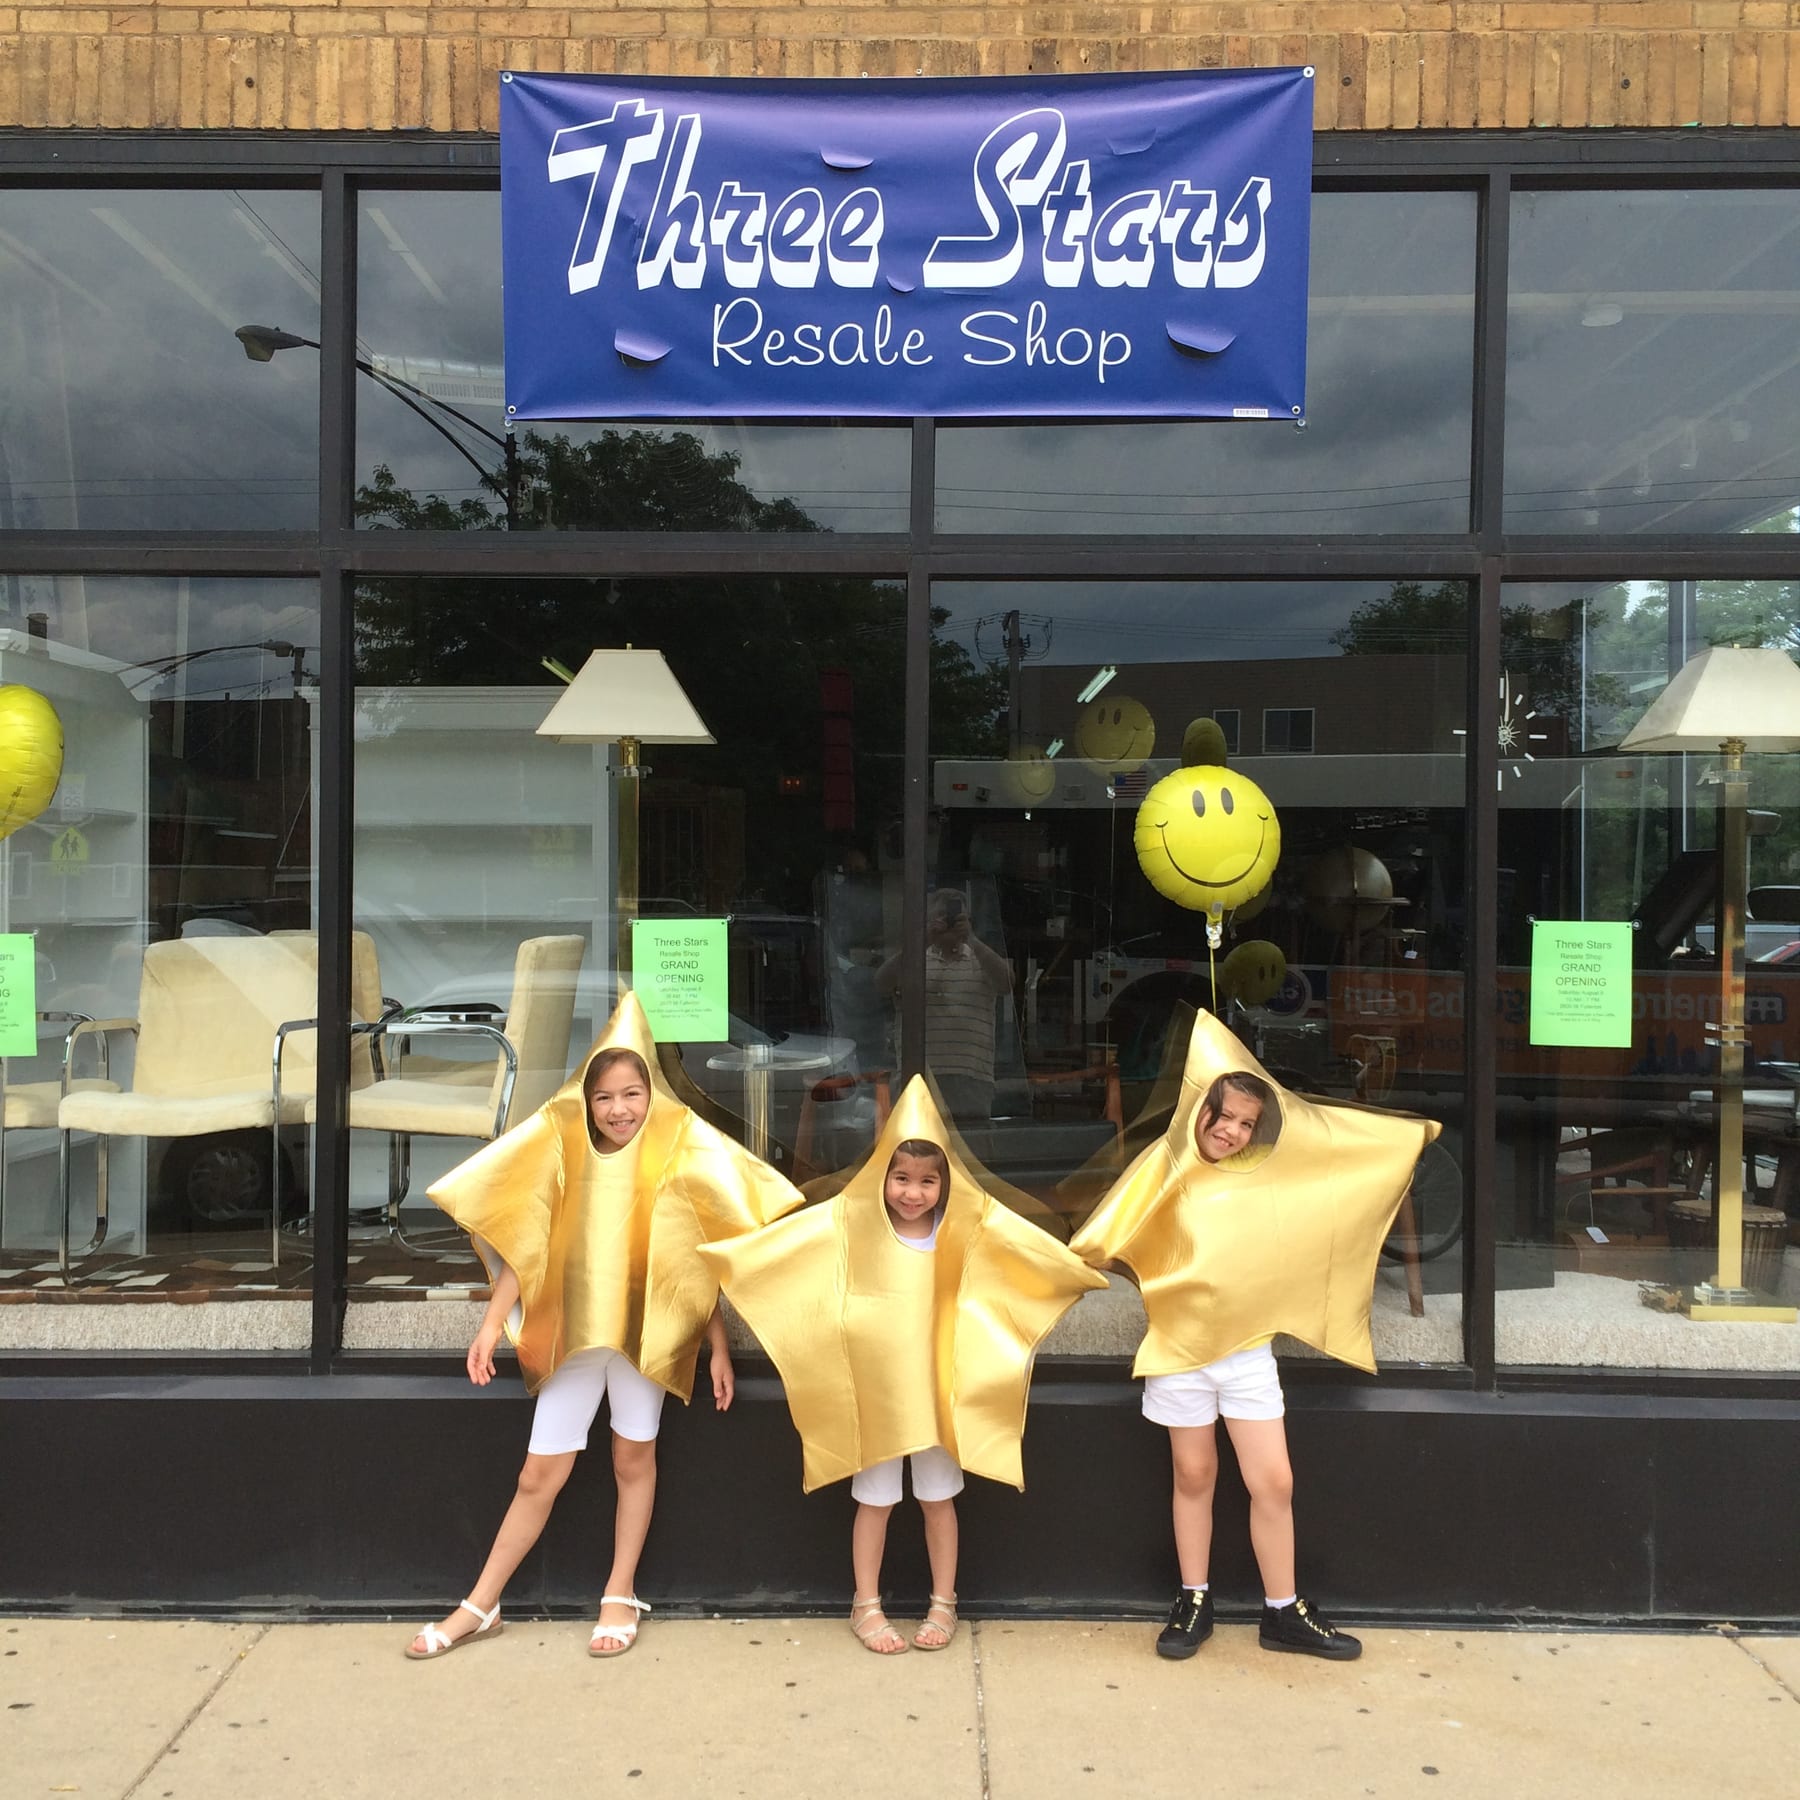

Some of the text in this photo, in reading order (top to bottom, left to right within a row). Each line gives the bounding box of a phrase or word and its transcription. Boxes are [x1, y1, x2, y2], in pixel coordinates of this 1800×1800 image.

[548, 97, 1272, 295] Three Stars
[711, 297, 1132, 383] Resale Shop
[654, 937, 709, 947] Three Stars
[1554, 939, 1612, 950] Three Stars
[660, 960, 699, 970] GRAND
[1561, 962, 1601, 973] GRAND
[655, 973, 705, 984] OPENING
[1555, 976, 1607, 987] OPENING
